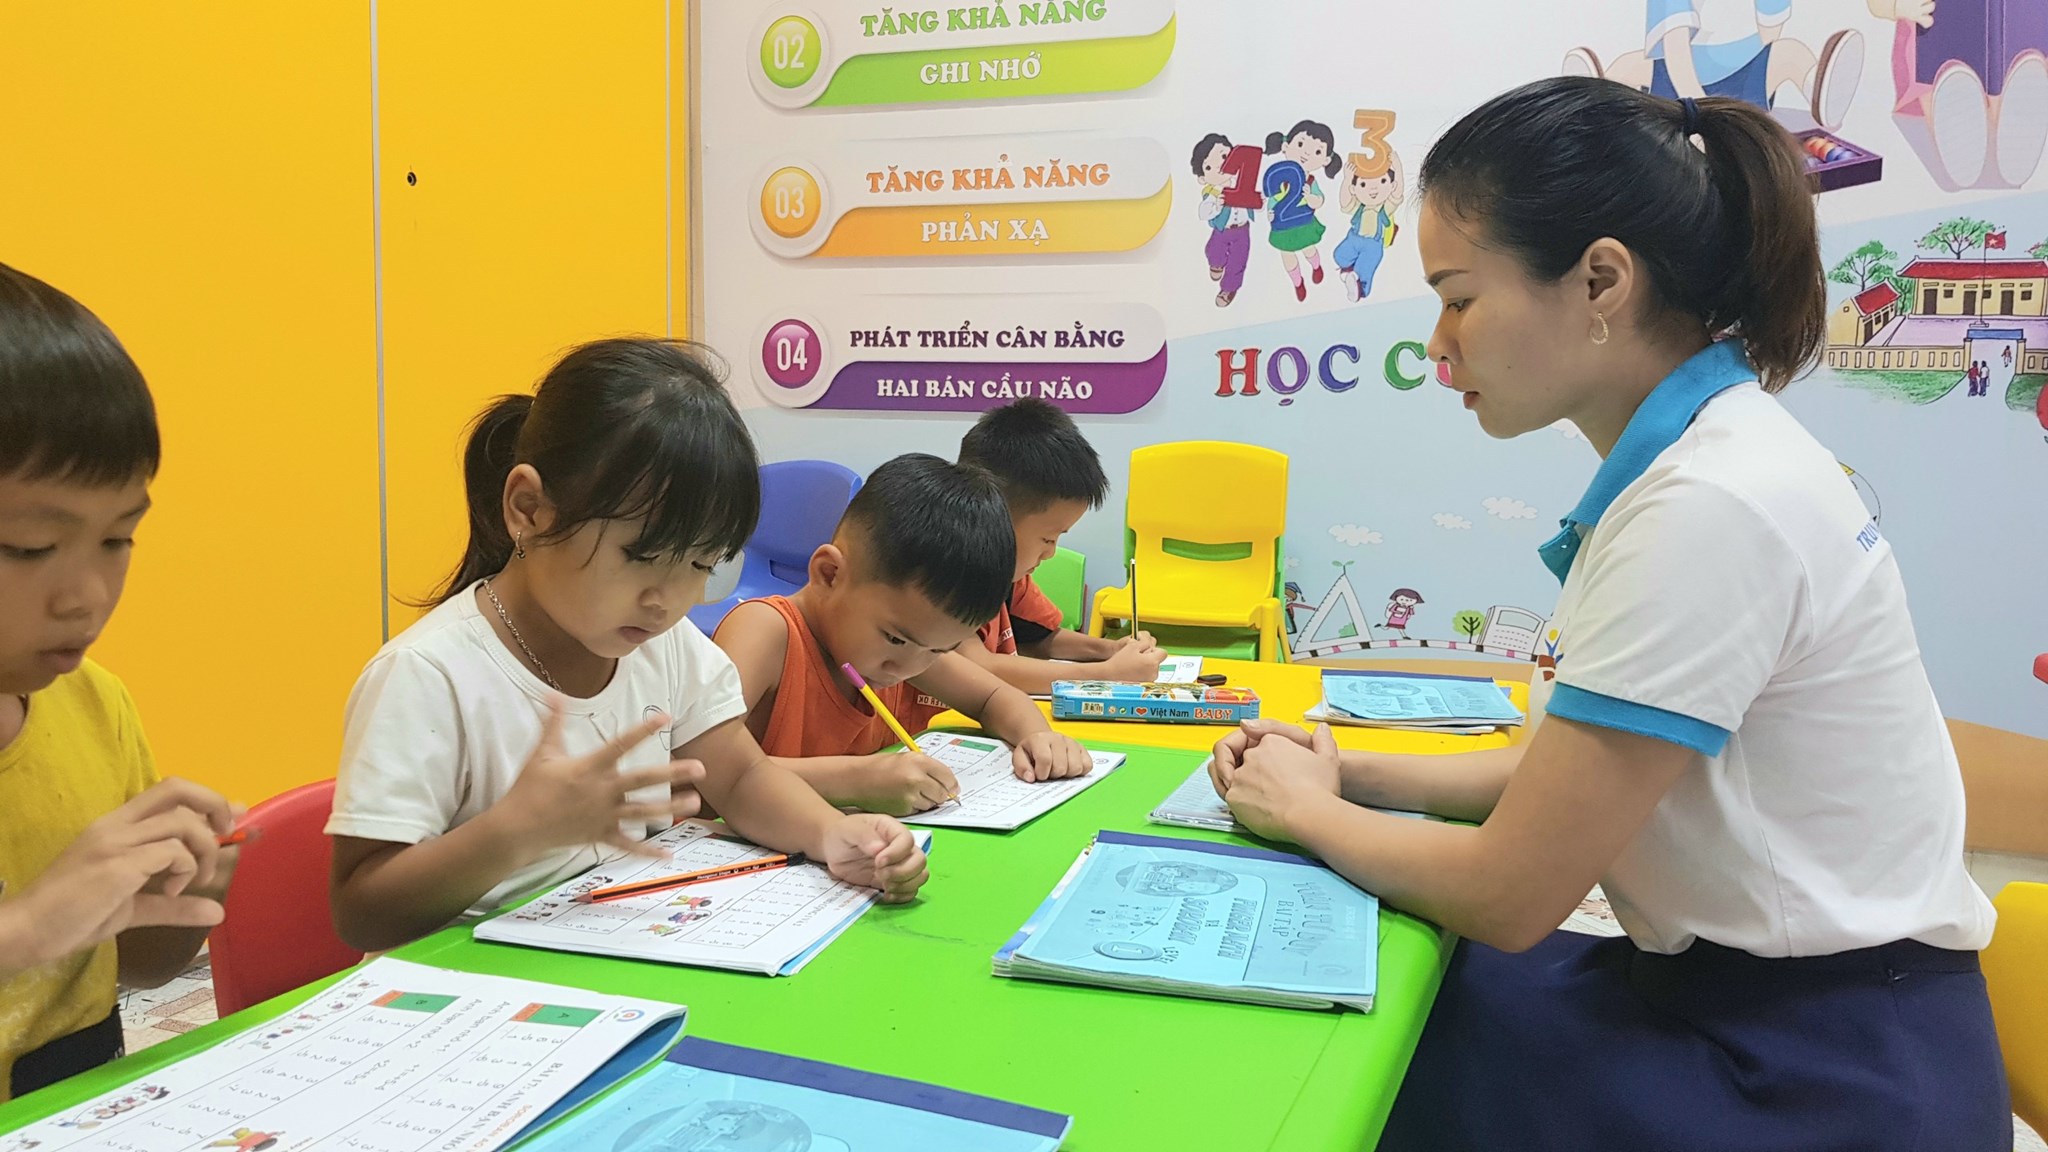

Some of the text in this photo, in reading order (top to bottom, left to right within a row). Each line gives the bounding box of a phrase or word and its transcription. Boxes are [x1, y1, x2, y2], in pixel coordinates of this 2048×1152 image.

[860, 8, 940, 37] TĂNG
[774, 34, 805, 70] 02
[920, 51, 1042, 85] GHI NHỚ
[866, 154, 1110, 194] TĂNG KHẢ NĂNG
[774, 187, 805, 219] 03
[921, 213, 1049, 246] PHẢN XẠ
[850, 320, 1125, 349] PHÁT TRIỂN CÂN BẰNG
[776, 338, 807, 371] 04
[877, 372, 1093, 399] HAI BÁN CẦU NÃO
[1214, 343, 1360, 406] HỌC
[1150, 706, 1168, 718] Việt
[1169, 708, 1190, 718] Nam
[1194, 708, 1234, 720] BABY
[1168, 897, 1209, 946] SOROBAN
[1153, 946, 1180, 964] LEVEL
[460, 999, 482, 1012] Anh
[488, 1001, 511, 1015] Anh
[497, 1090, 524, 1110] ANH
